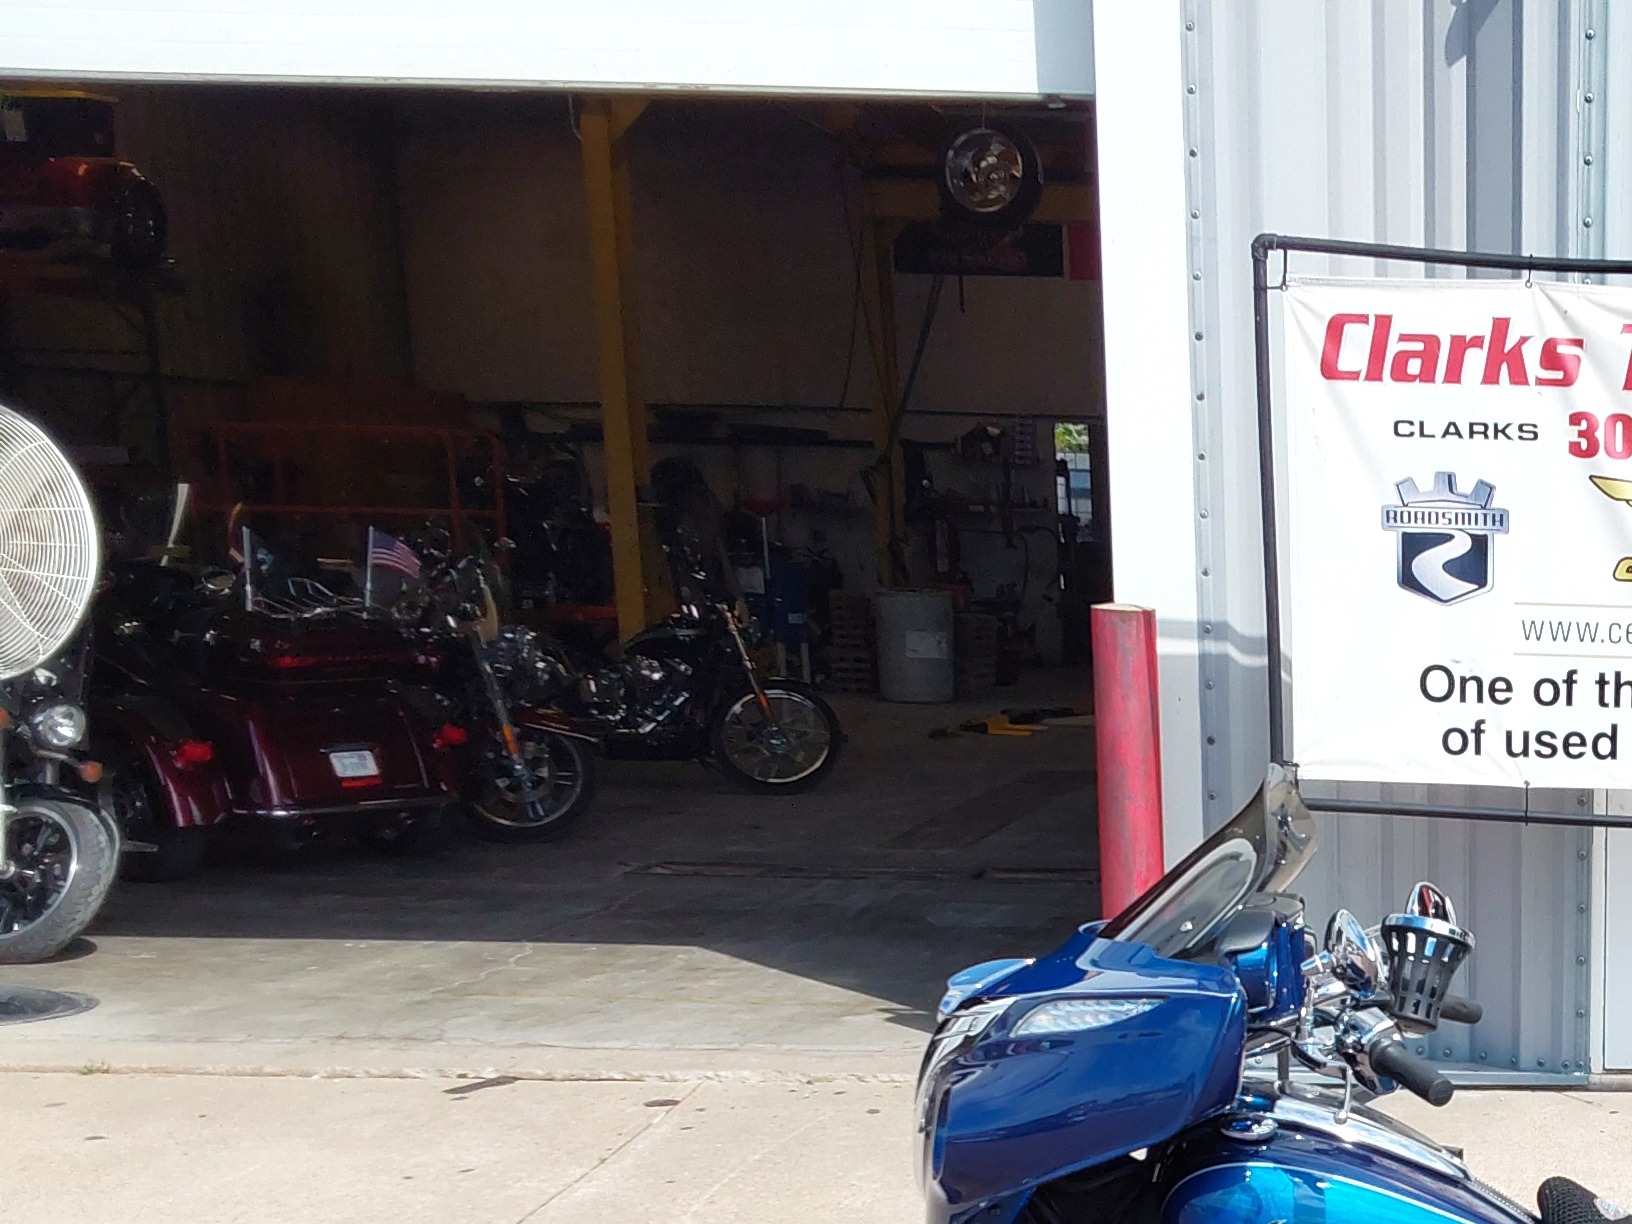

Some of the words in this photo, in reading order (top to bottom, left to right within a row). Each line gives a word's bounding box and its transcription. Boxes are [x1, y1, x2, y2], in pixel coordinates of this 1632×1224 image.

[1319, 312, 1585, 387] Clarks
[1392, 419, 1540, 442] CLARKS
[1385, 509, 1505, 528] ROADSMITH
[1419, 663, 1514, 706] One
[1532, 668, 1578, 707] of
[1441, 719, 1486, 756] of
[1505, 723, 1618, 761] used
